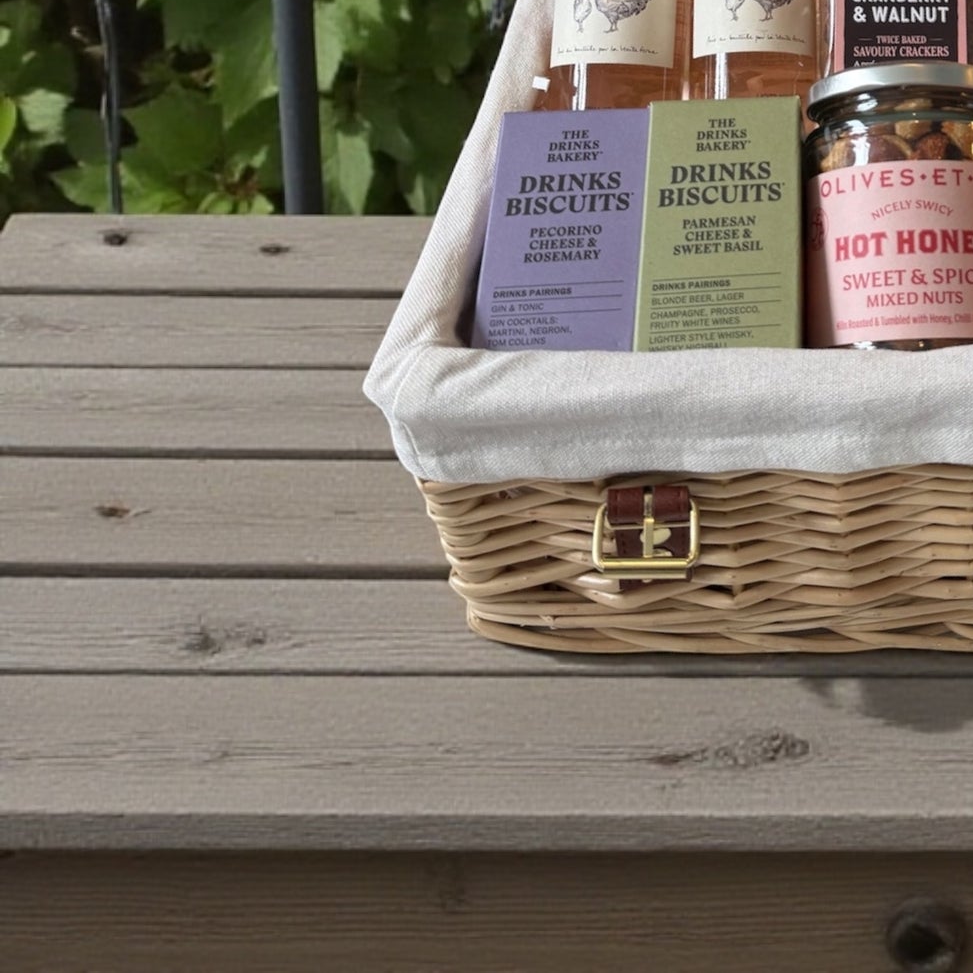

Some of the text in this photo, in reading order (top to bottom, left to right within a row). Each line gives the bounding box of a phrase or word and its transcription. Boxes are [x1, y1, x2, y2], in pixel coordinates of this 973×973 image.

[853, 6, 950, 23] & WALNUT
[876, 35, 927, 44] TWICE BAKED
[853, 46, 950, 57] SAVOURY CRACKERS
[708, 118, 736, 128] THE
[562, 129, 590, 140] THE
[697, 128, 747, 140] DRINKS
[548, 140, 600, 152] DRINKS
[696, 140, 748, 152] BAKERY
[547, 151, 600, 163] BAKERY
[670, 161, 771, 185] DRINKS
[519, 171, 622, 195] DRINKS
[658, 183, 782, 208] BISCUITS
[505, 192, 632, 217] BISCUITS
[871, 199, 954, 221] NICELY SWICY
[682, 215, 756, 230] PARMESAN
[530, 224, 602, 239] PECORINO
[685, 229, 752, 242] CHEESE &
[529, 238, 597, 250] CHEESE &
[673, 241, 763, 256] SWEET BASIL
[834, 231, 888, 262] HOT
[523, 249, 602, 264] ROSEMARY
[652, 279, 731, 291] DRINKS PAIRINGS
[842, 269, 907, 291] SWEET
[911, 268, 928, 285] &
[493, 287, 572, 298] DRINKS PAIRINGS
[651, 296, 687, 306] BLONDE
[716, 292, 744, 301] LAGER
[866, 291, 964, 308] MIXED NUTS
[491, 305, 507, 313] GIN
[518, 303, 544, 311] TONIC
[489, 319, 505, 328] GIN
[650, 316, 741, 330] FRUITY WHITE WINES
[529, 326, 573, 336] NEGRONI,
[487, 337, 546, 347] TOM COLLINS
[649, 334, 687, 344] LIGHTER
[688, 332, 716, 342] STYLE
